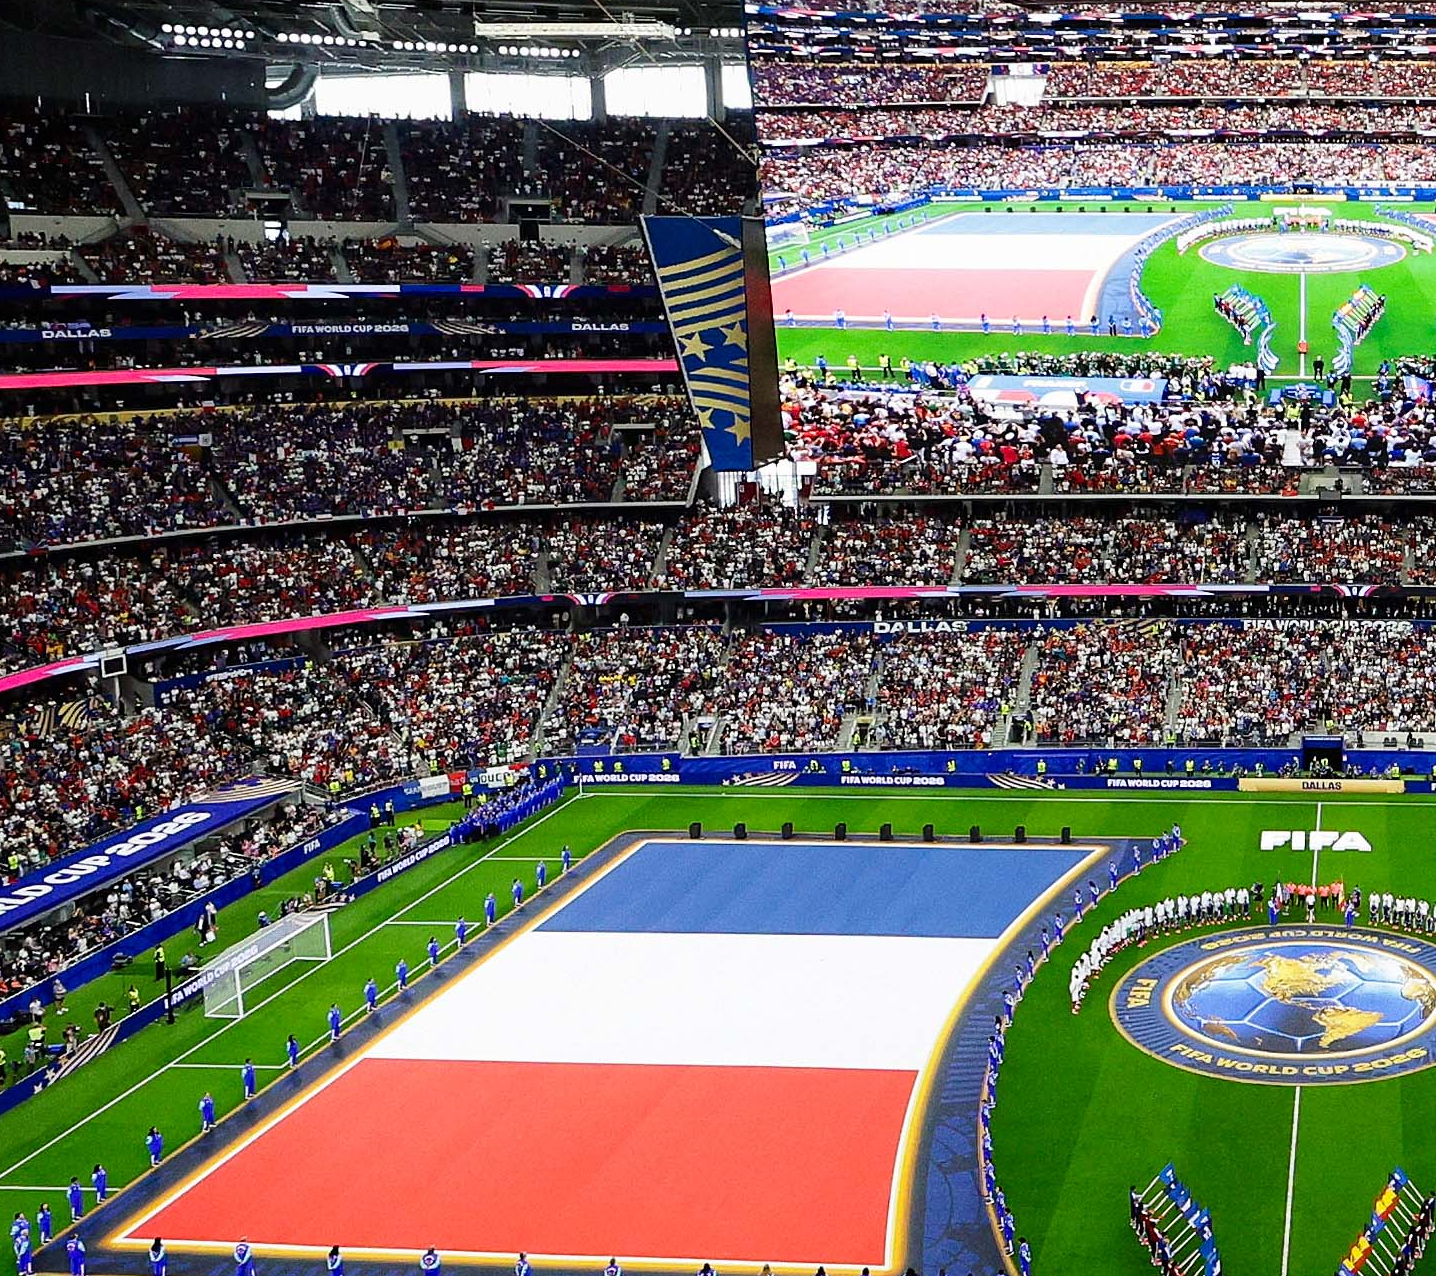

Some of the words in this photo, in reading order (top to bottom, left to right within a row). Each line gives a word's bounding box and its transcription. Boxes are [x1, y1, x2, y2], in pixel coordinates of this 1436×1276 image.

[291, 324, 314, 333] FIFA
[315, 324, 352, 333] WORLD
[353, 324, 374, 333] CUP
[375, 324, 409, 333] 2026
[572, 322, 629, 331] DALLAS
[41, 328, 112, 339] DALLAS
[873, 621, 968, 634] DALLAS
[1243, 619, 1276, 631] FIFA
[773, 760, 797, 770] FIFA
[573, 774, 594, 783] FIFA
[595, 774, 629, 782] WORLD
[629, 774, 648, 782] CUP
[649, 773, 680, 782] 2026
[841, 776, 861, 784] FIFA
[861, 776, 893, 784] WORLD
[894, 776, 912, 785] CUP
[913, 776, 945, 785] 2026
[1107, 779, 1127, 787] FIFA
[1128, 779, 1160, 787] WORLD
[1161, 779, 1179, 788] CUP
[1180, 779, 1212, 788] 2026
[1302, 781, 1342, 791] DALLAS
[303, 838, 321, 854] FIFA
[1260, 829, 1372, 853] FIFA
[44, 855, 112, 885] CUP
[105, 812, 212, 857] 2026
[378, 867, 392, 882] FIFA
[392, 855, 416, 874] WORLD
[415, 848, 429, 864] CUP
[429, 836, 450, 854] 2026
[1127, 978, 1152, 1009] FIFA
[1171, 1043, 1212, 1064] FIFA
[1216, 1057, 1299, 1076] WORLD
[1302, 1065, 1350, 1076] CUP
[1353, 1048, 1427, 1073] 2026
